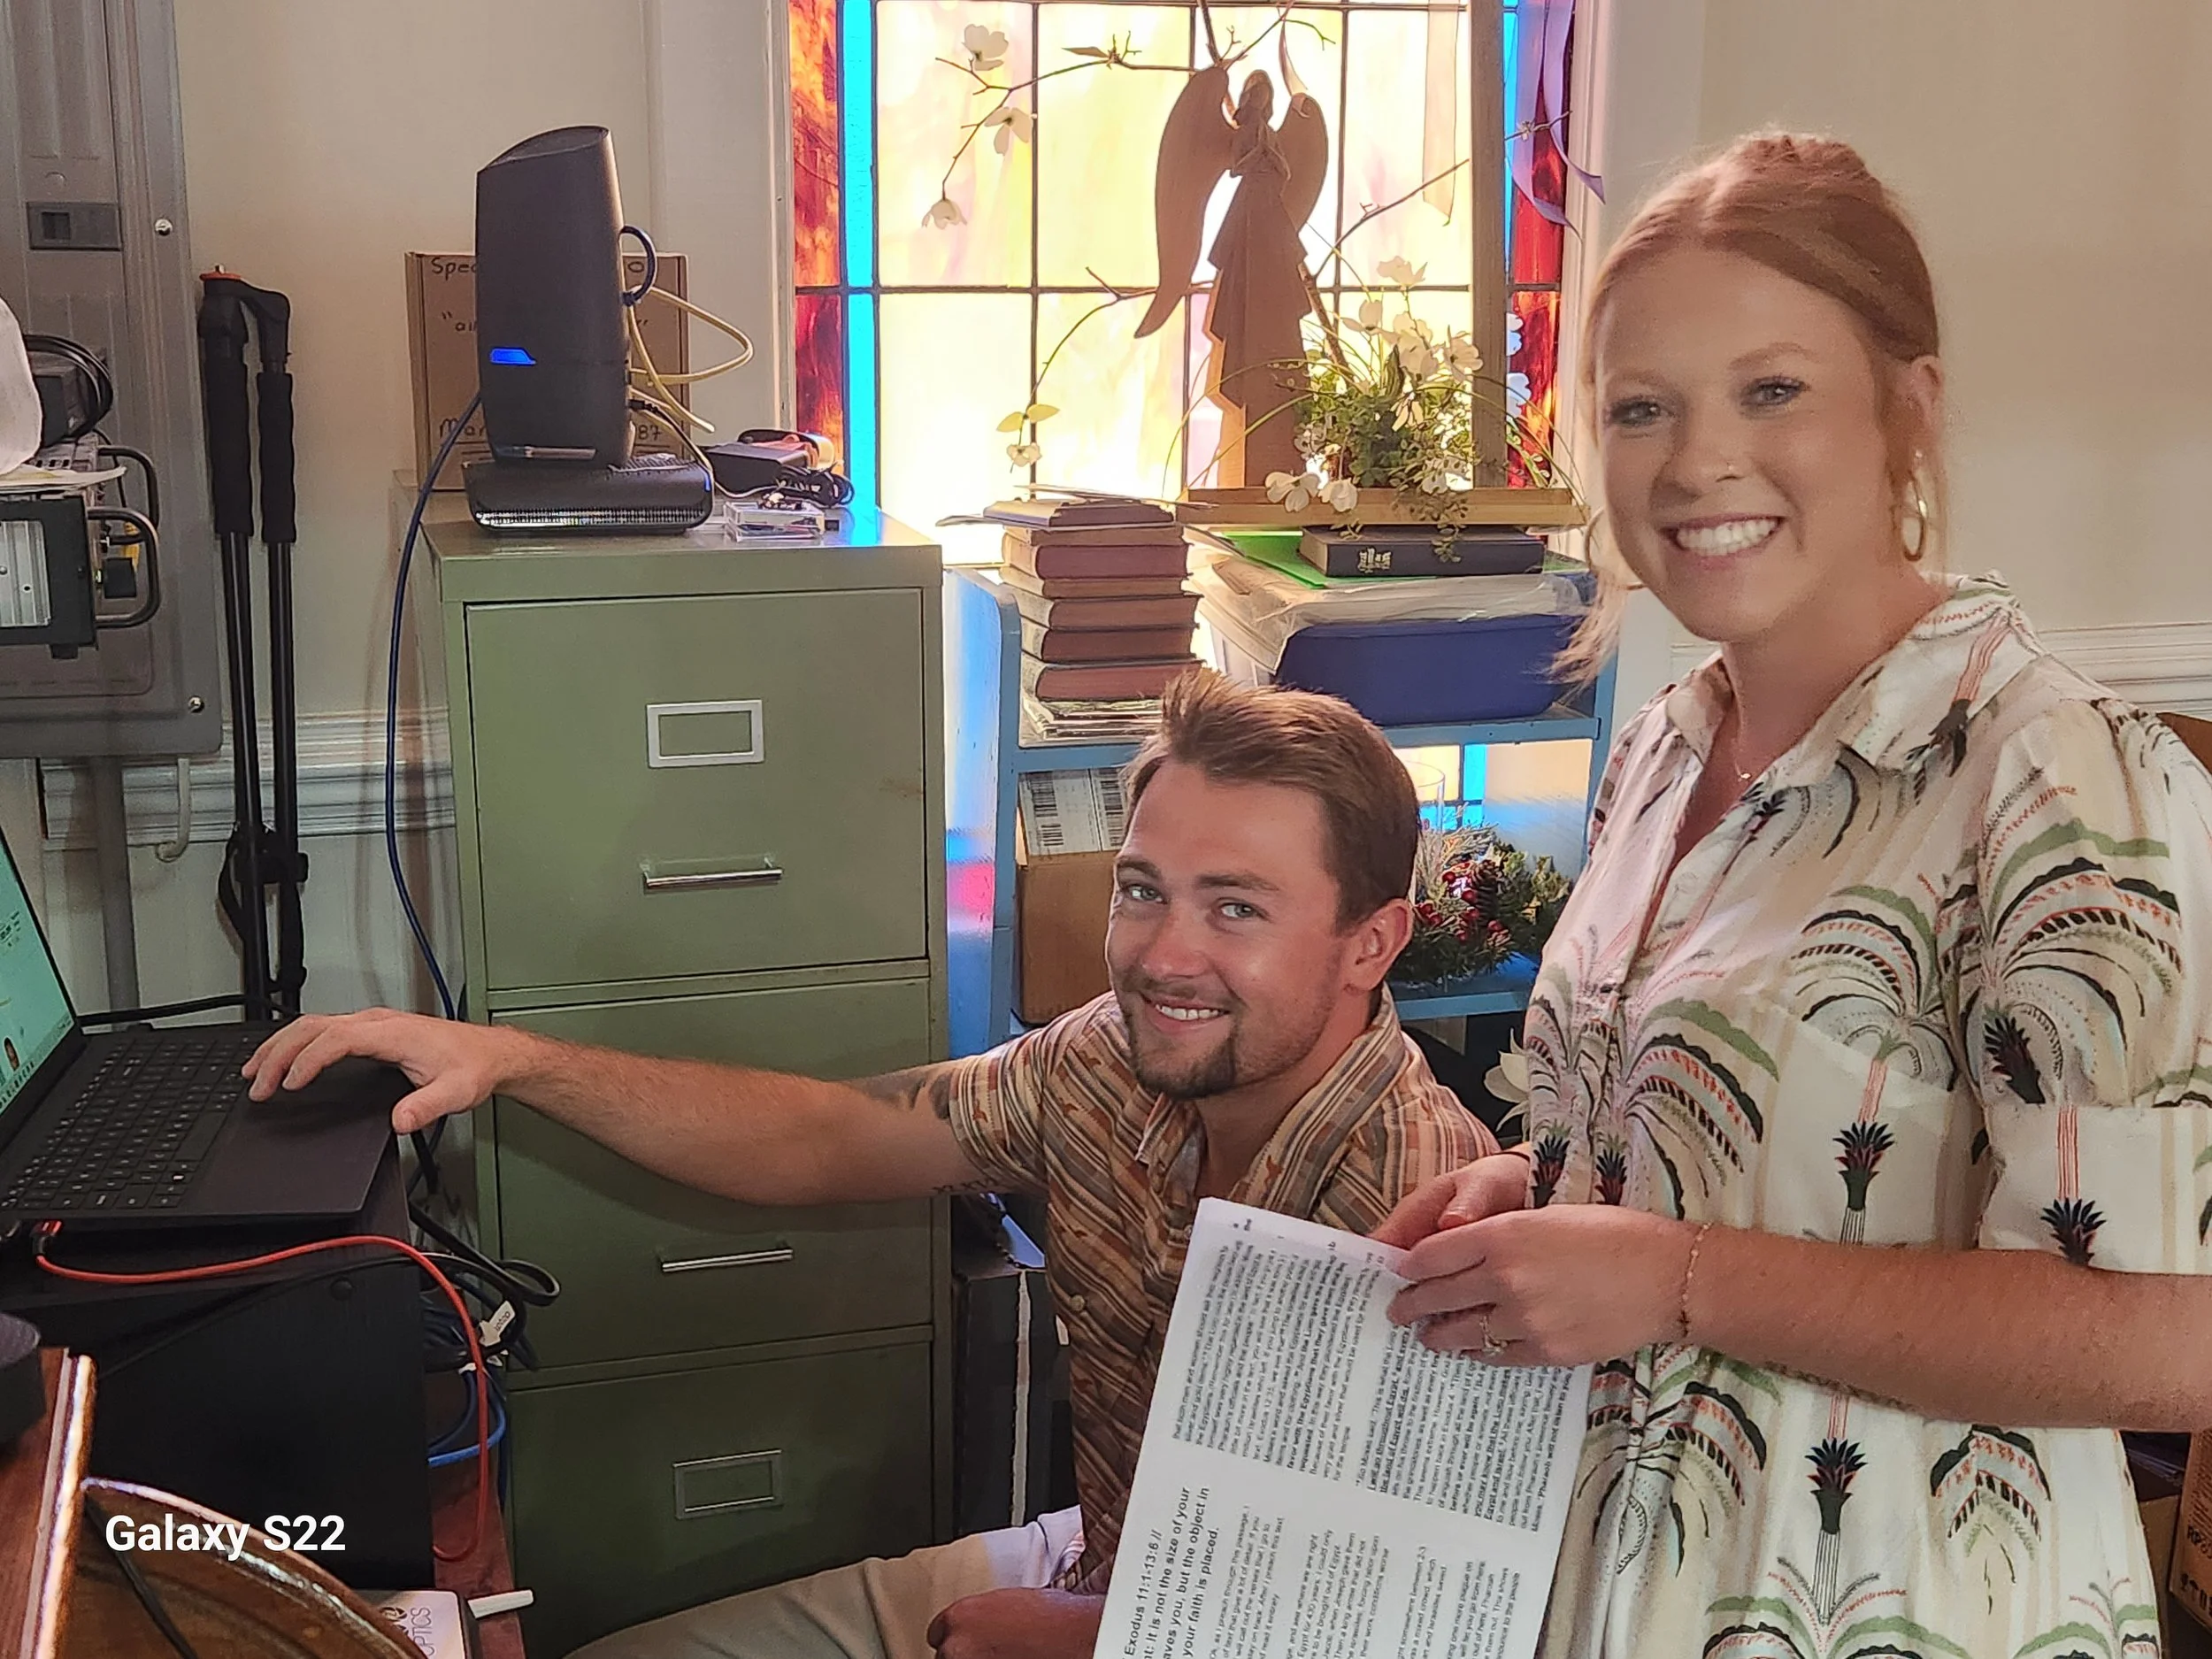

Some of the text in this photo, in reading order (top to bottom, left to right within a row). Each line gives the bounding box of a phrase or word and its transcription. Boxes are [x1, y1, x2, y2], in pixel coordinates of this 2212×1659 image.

[1175, 1486, 1193, 1519] your
[1197, 1486, 1210, 1500] in
[1170, 1519, 1182, 1534] of
[1187, 1502, 1207, 1544] object
[1164, 1537, 1179, 1564] size
[1181, 1546, 1194, 1568] the
[1158, 1567, 1171, 1588] the
[1176, 1571, 1189, 1593] but
[1153, 1591, 1165, 1613] not
[1182, 1525, 1220, 1657] your faith is placed.
[1171, 1595, 1187, 1625] you,
[1125, 1604, 1144, 1655] Exodus
[1148, 1617, 1161, 1629] is
[1145, 1631, 1157, 1641] It
